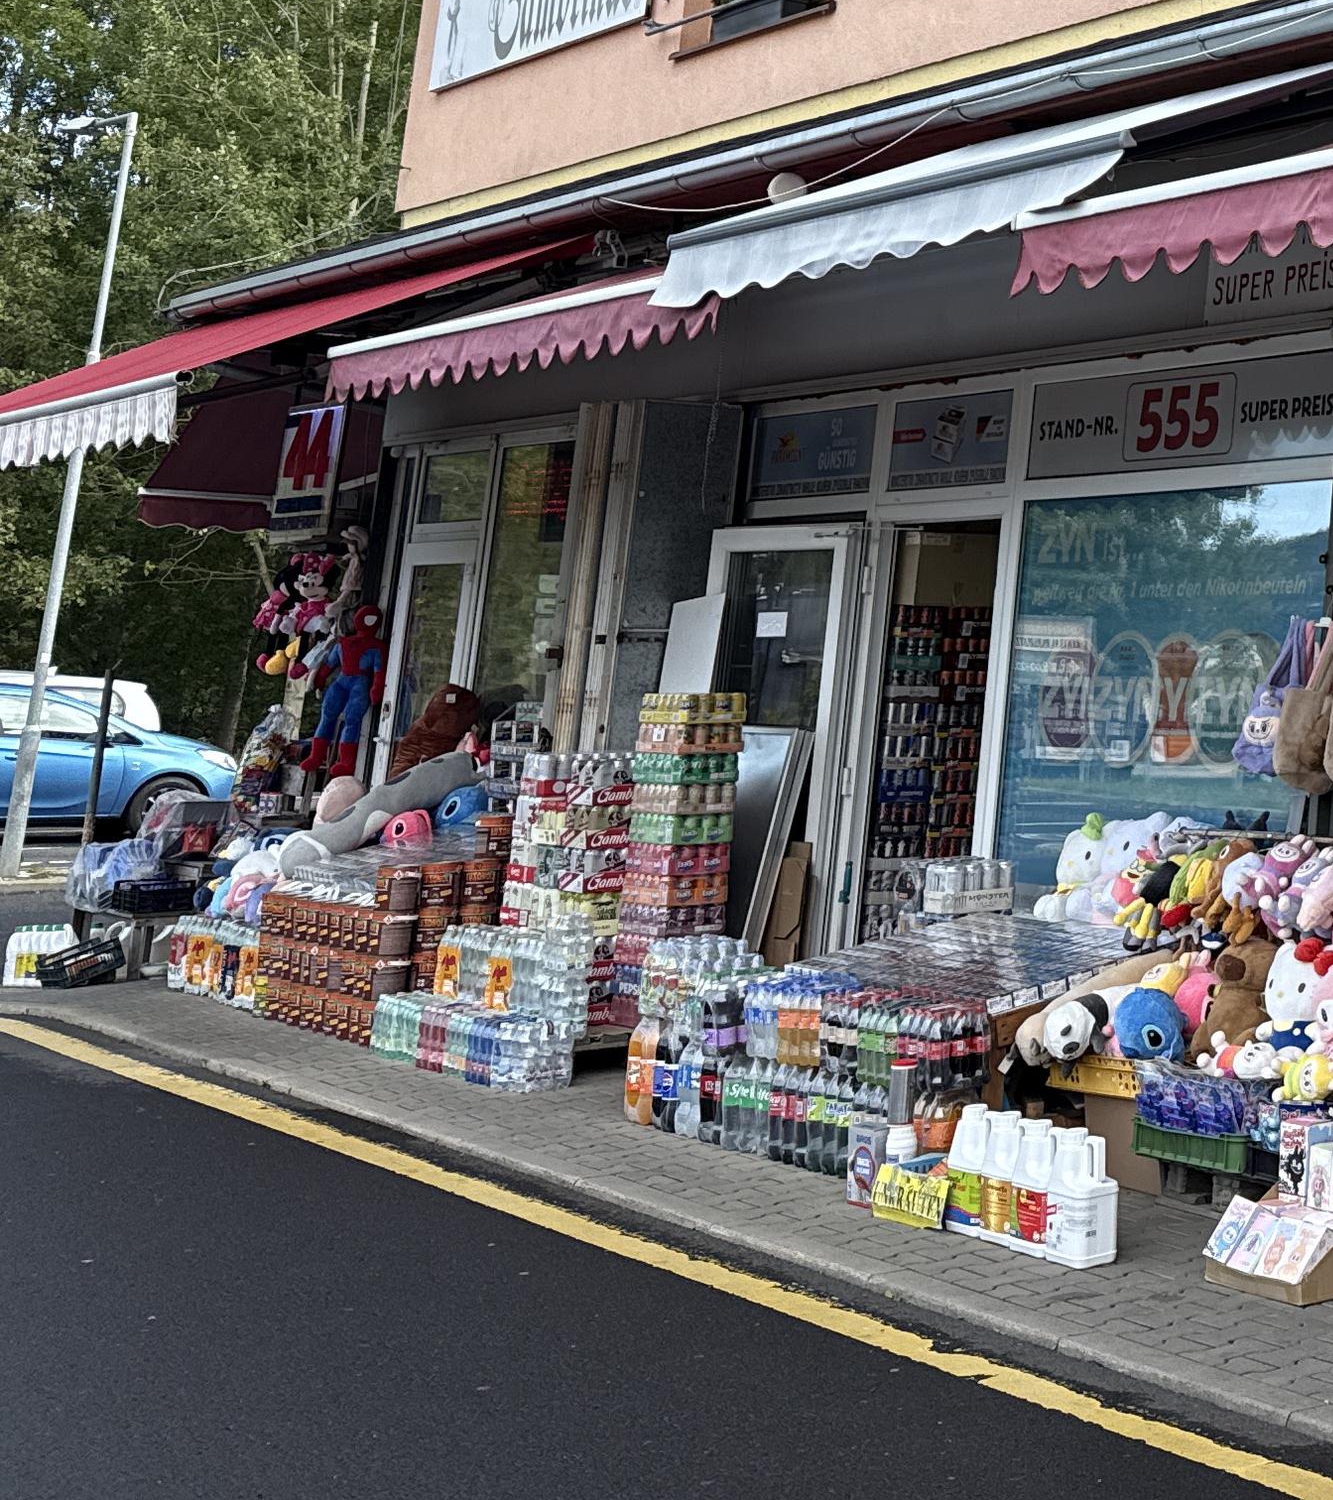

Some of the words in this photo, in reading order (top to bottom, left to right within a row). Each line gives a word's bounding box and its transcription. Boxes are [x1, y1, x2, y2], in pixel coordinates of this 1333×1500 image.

[1213, 269, 1273, 306] SUPER
[1039, 415, 1119, 442] STAND-NR.
[1136, 382, 1221, 453] 555
[1240, 398, 1289, 424] SUPER
[1037, 521, 1098, 564] ZYN
